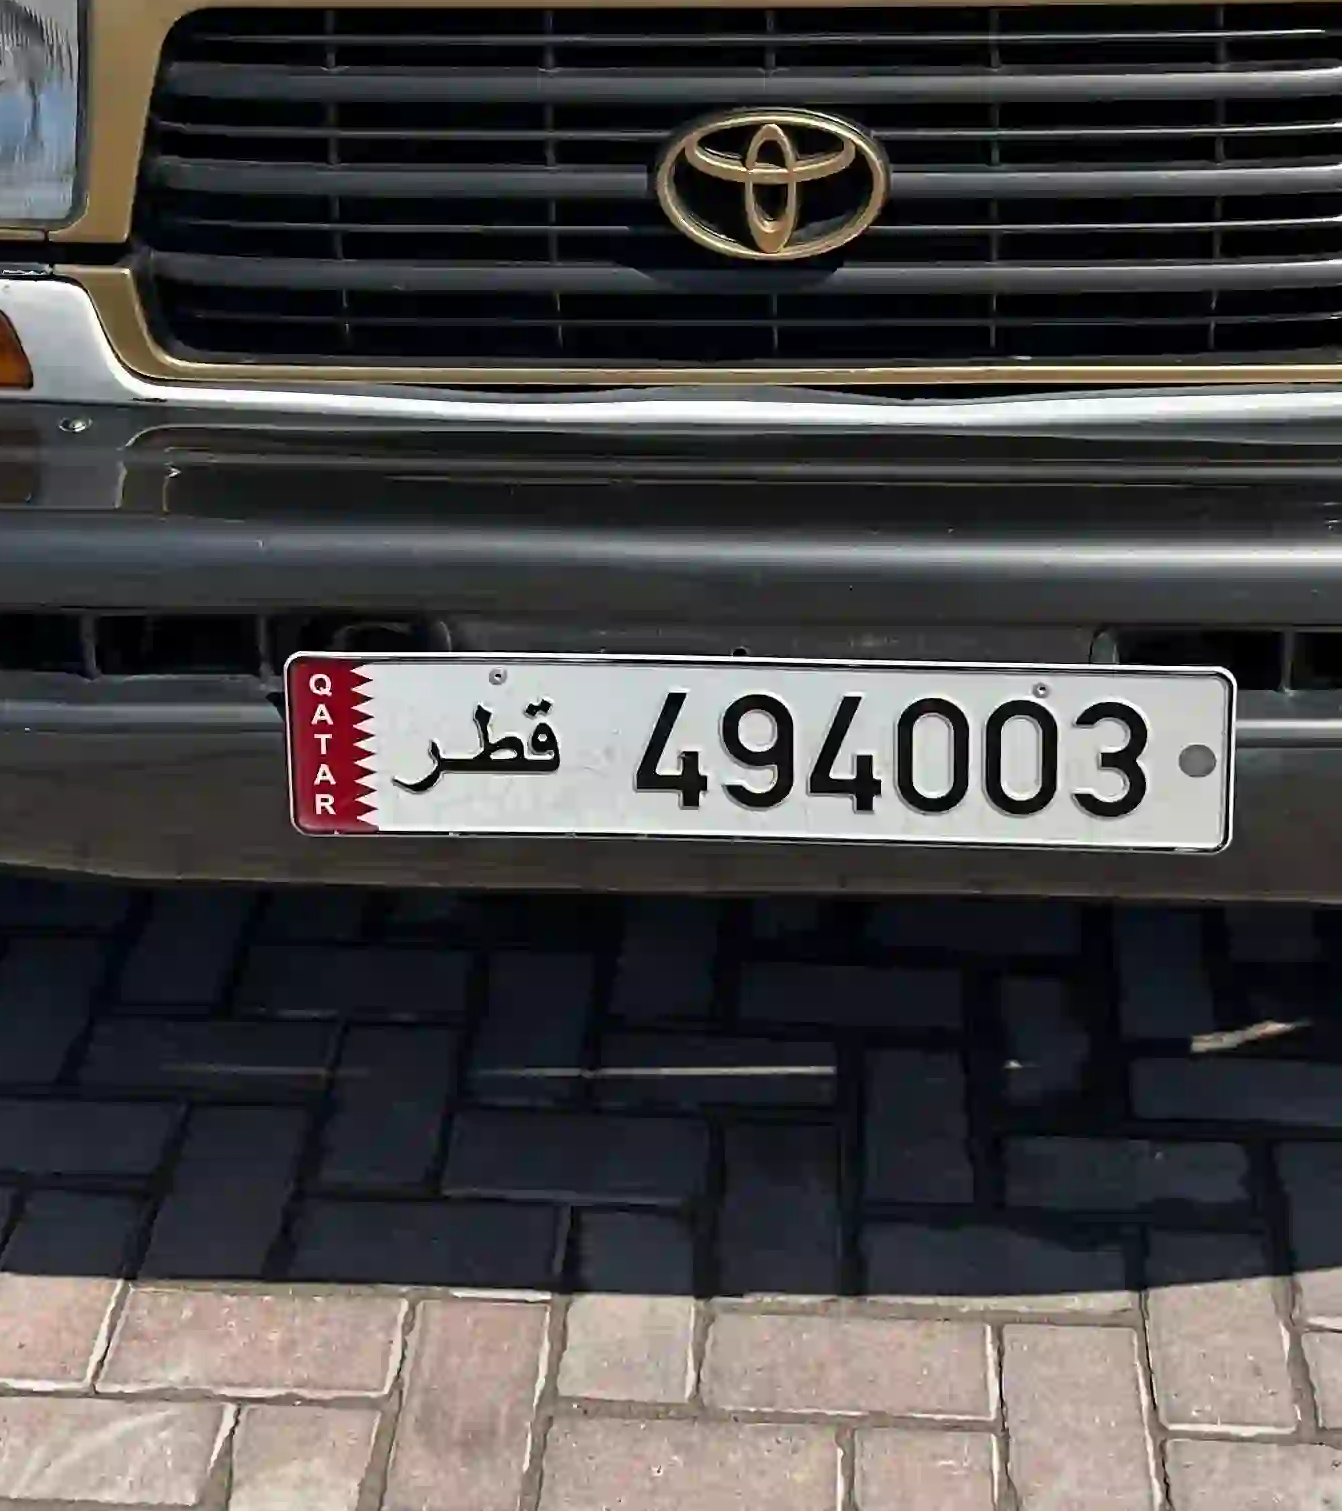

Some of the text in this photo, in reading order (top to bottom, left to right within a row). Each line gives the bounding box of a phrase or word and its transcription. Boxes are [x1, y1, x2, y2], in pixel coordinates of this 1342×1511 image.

[309, 673, 337, 815] QATAR
[392, 698, 560, 793] قطر
[634, 688, 1148, 818] 494003
